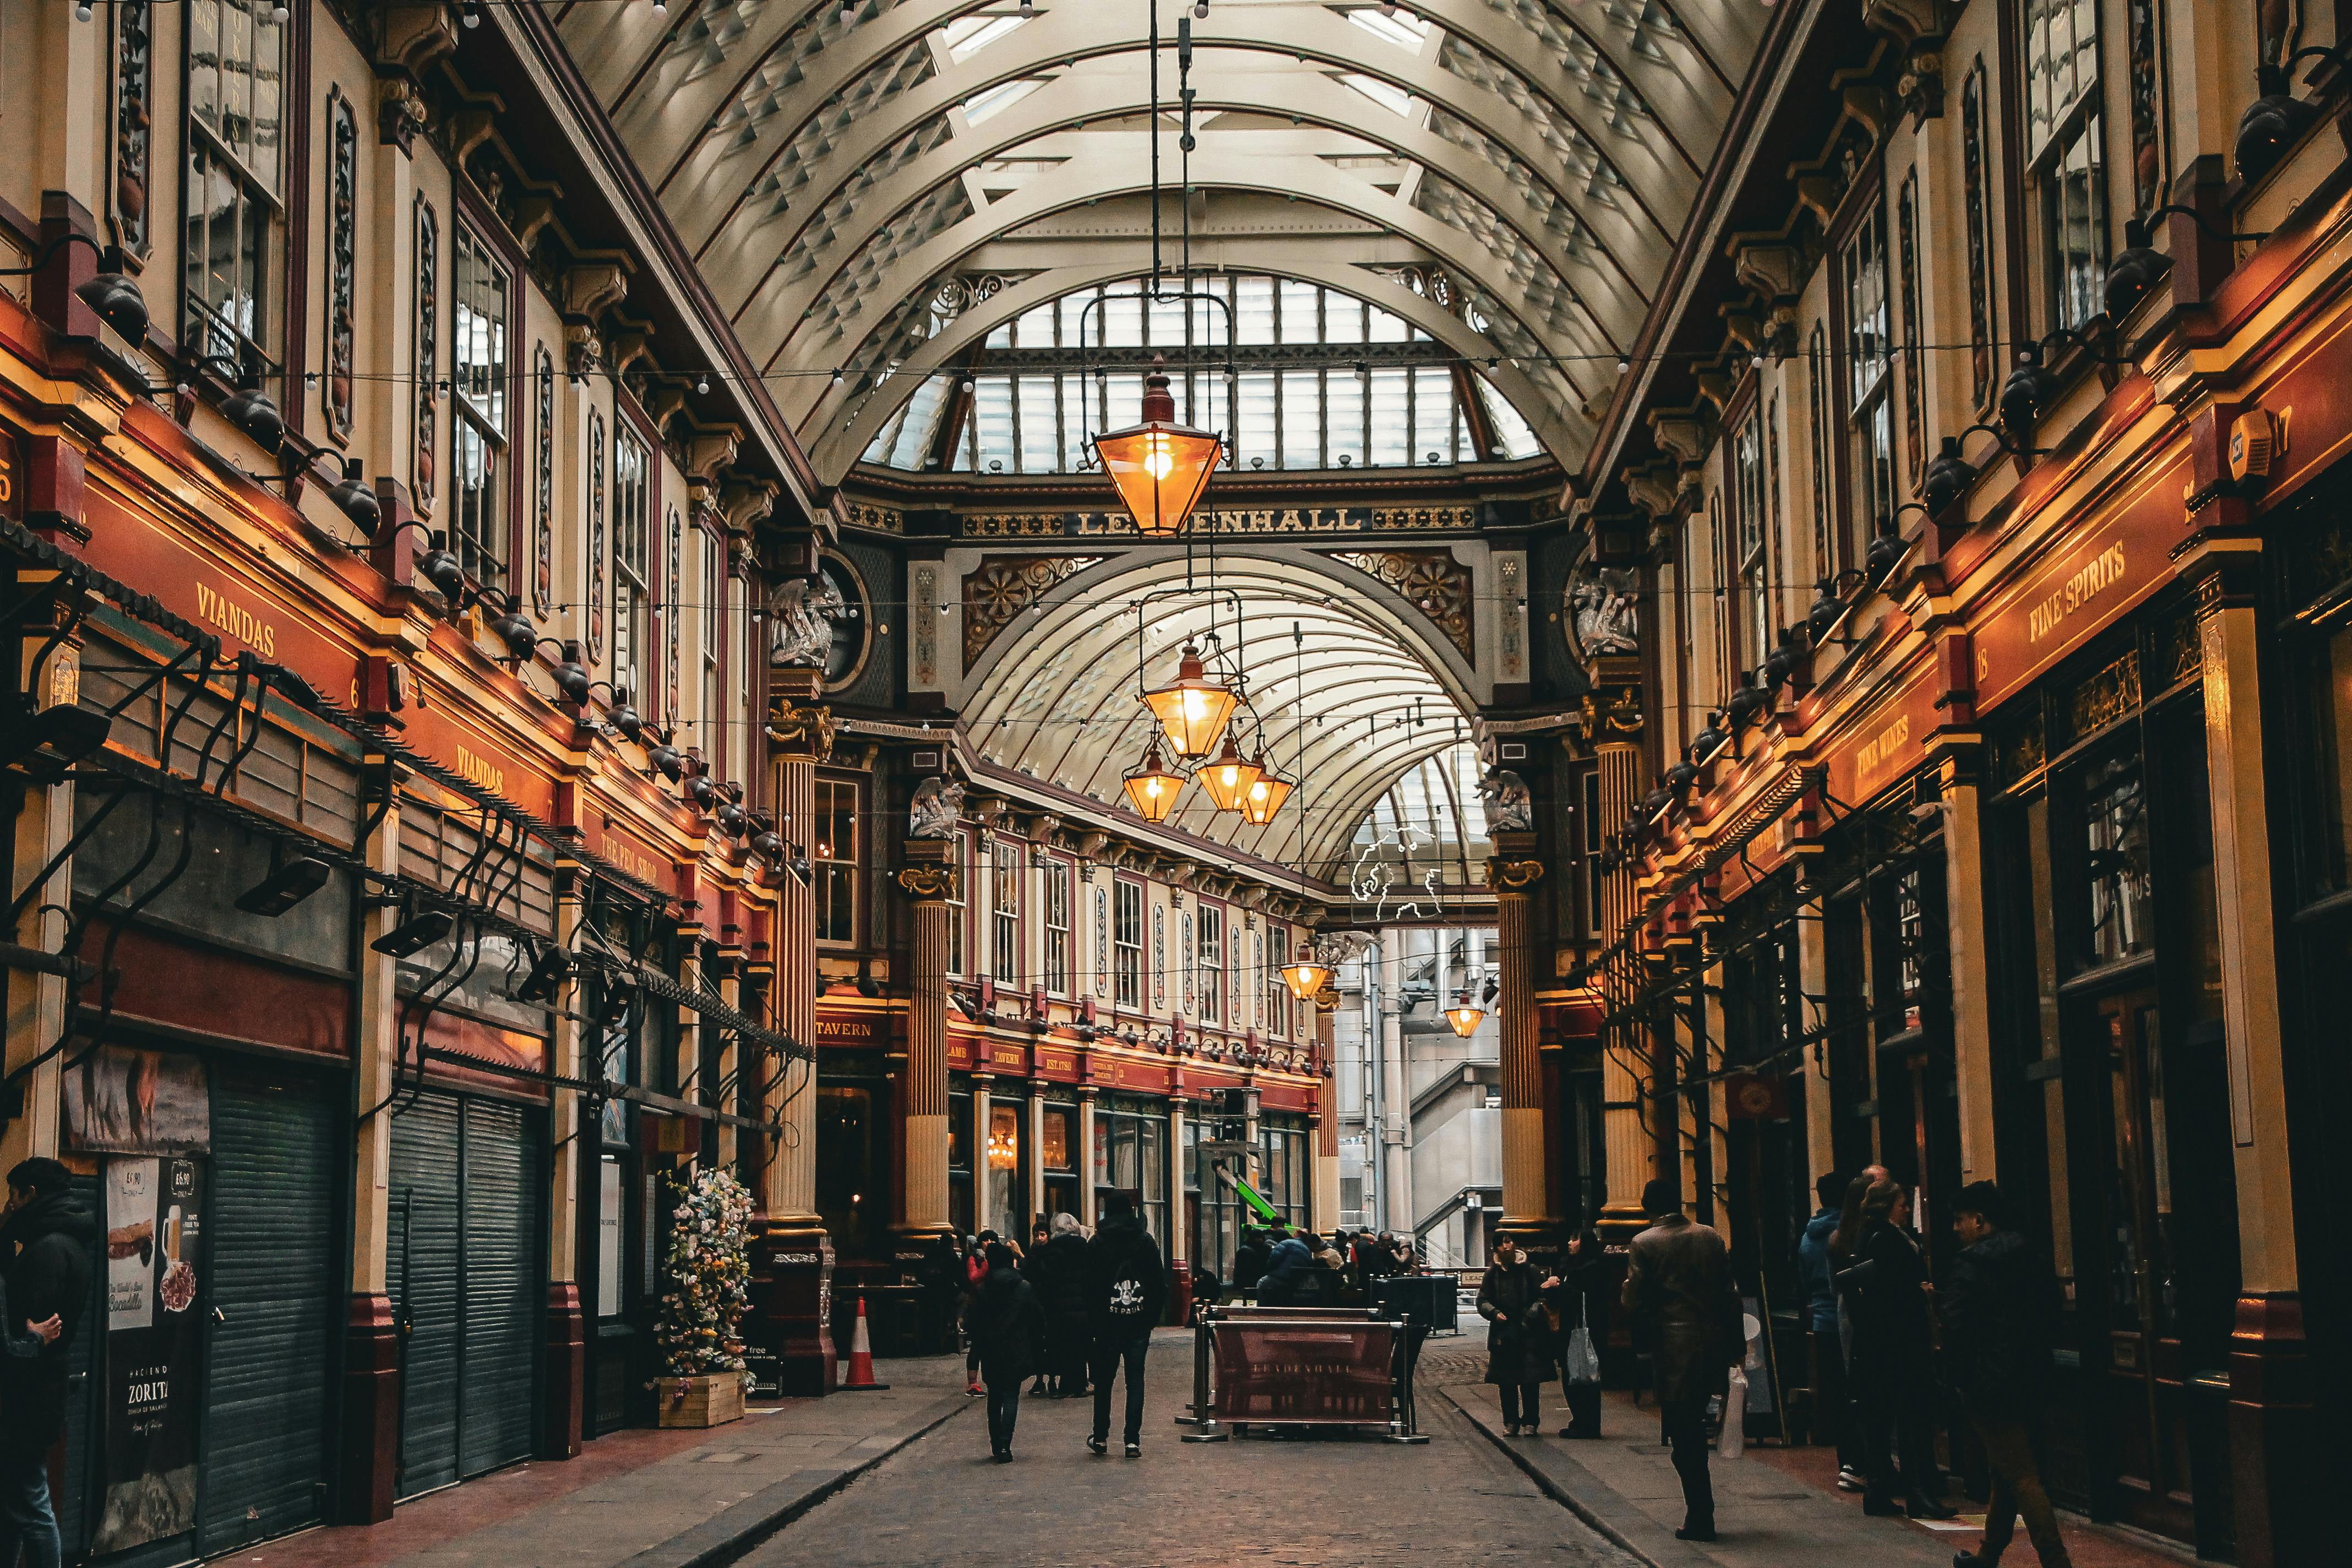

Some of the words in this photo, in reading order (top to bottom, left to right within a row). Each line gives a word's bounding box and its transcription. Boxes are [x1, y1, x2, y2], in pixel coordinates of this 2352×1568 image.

[2029, 589, 2062, 643] FINE
[2066, 539, 2125, 615] SPIRITS
[197, 581, 274, 658] VIANDAS
[1978, 647, 1988, 682] 18
[351, 678, 359, 709] 6
[1880, 714, 1909, 759] WINES
[456, 744, 503, 795] VIANDAS
[601, 833, 618, 863] THE
[619, 844, 635, 872] PEN
[638, 856, 657, 889] SHOP
[815, 1022, 871, 1036] TAVERN
[994, 1052, 1019, 1064] TAVERN
